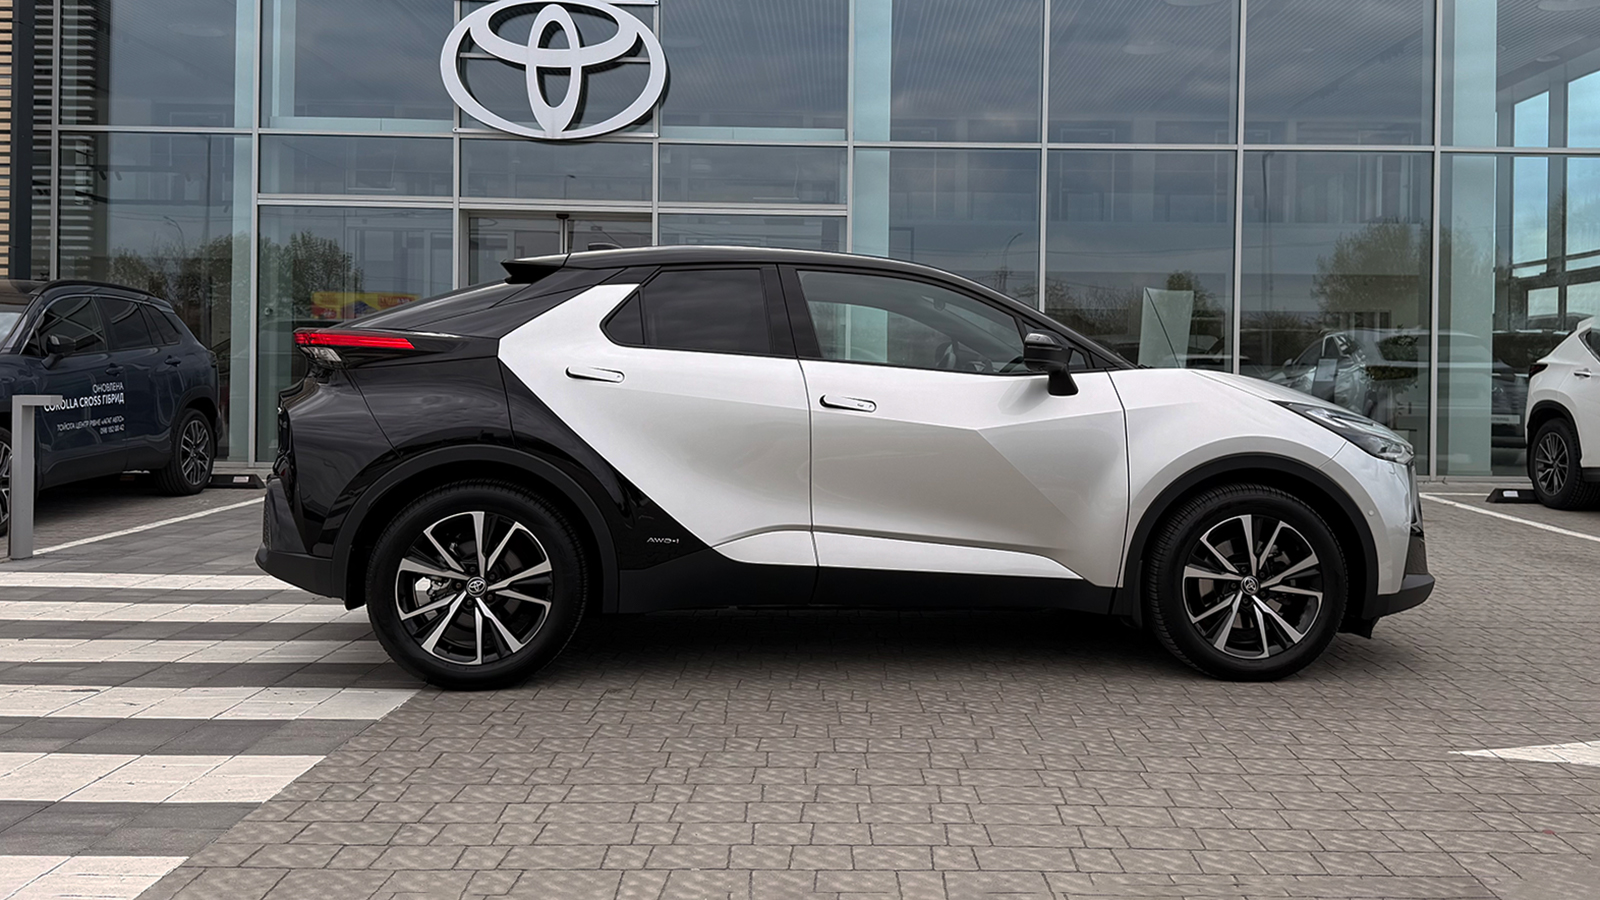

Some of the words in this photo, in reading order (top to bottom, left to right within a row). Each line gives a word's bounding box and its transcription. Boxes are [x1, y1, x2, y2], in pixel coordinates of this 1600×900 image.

[92, 382, 124, 393] ОНОВЛЕНА
[79, 395, 101, 408] CROSS
[102, 393, 124, 405] ГІБРИД
